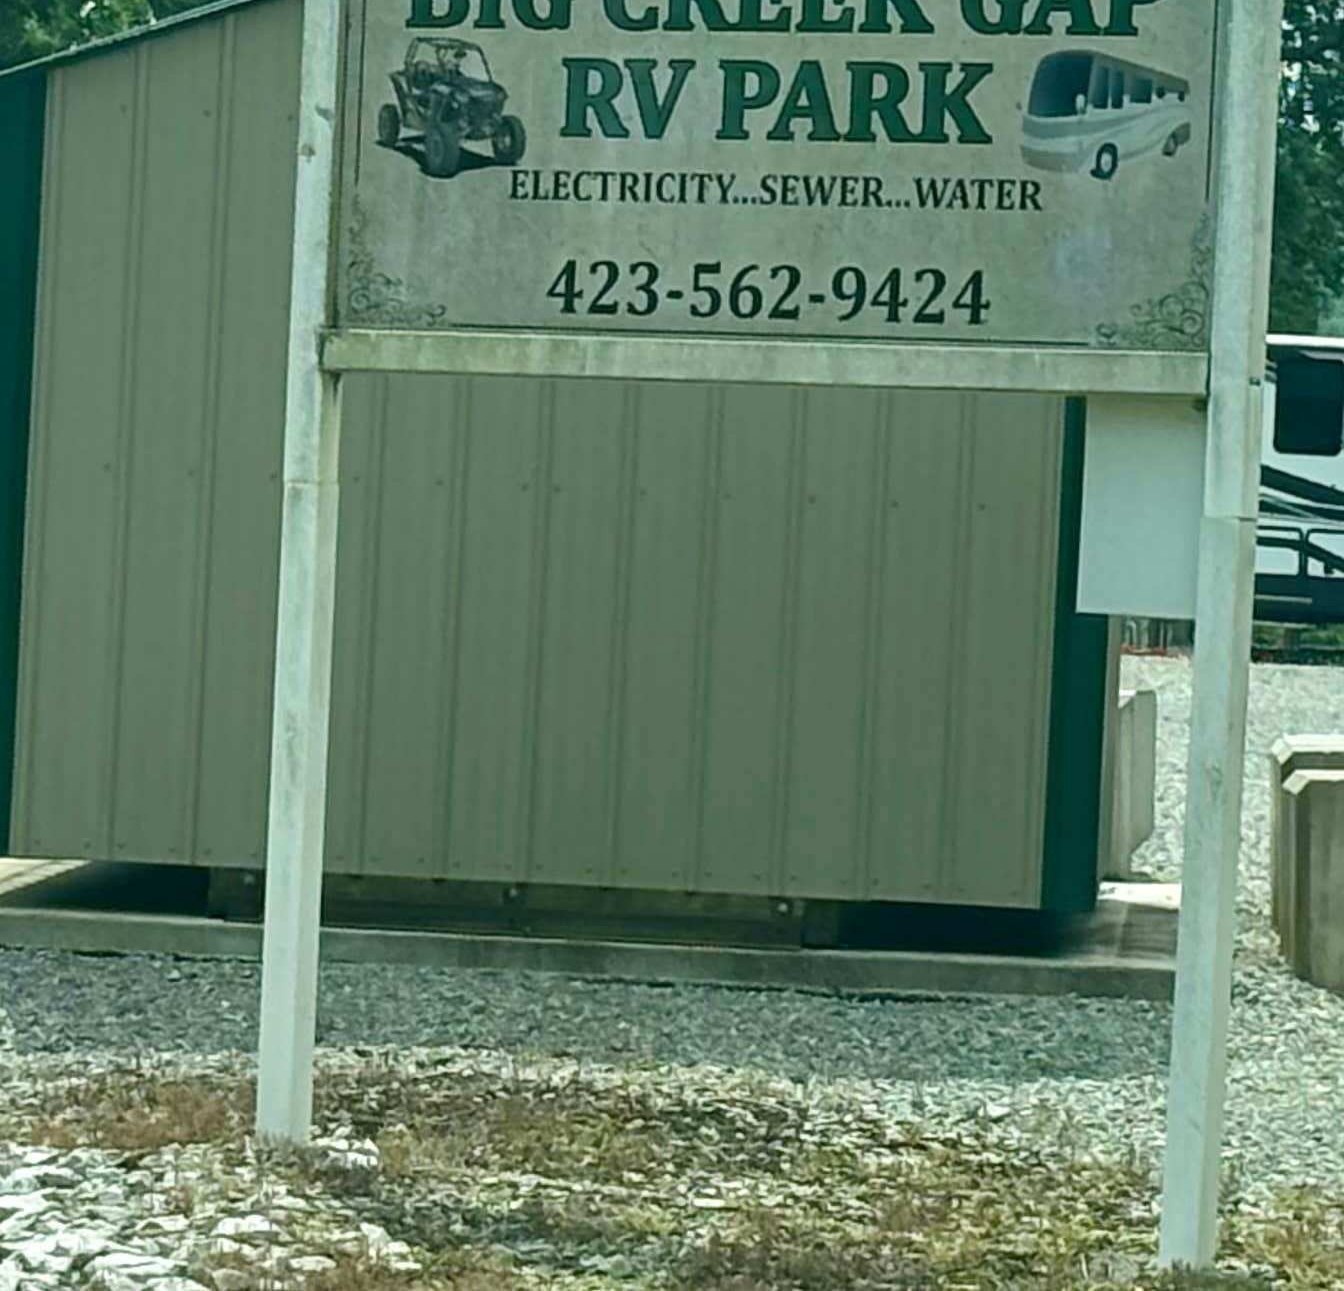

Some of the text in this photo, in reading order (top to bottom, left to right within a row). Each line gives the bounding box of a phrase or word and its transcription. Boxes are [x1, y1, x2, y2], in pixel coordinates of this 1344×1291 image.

[559, 56, 995, 145] RV PARK
[546, 259, 992, 326] 423-562-9424
